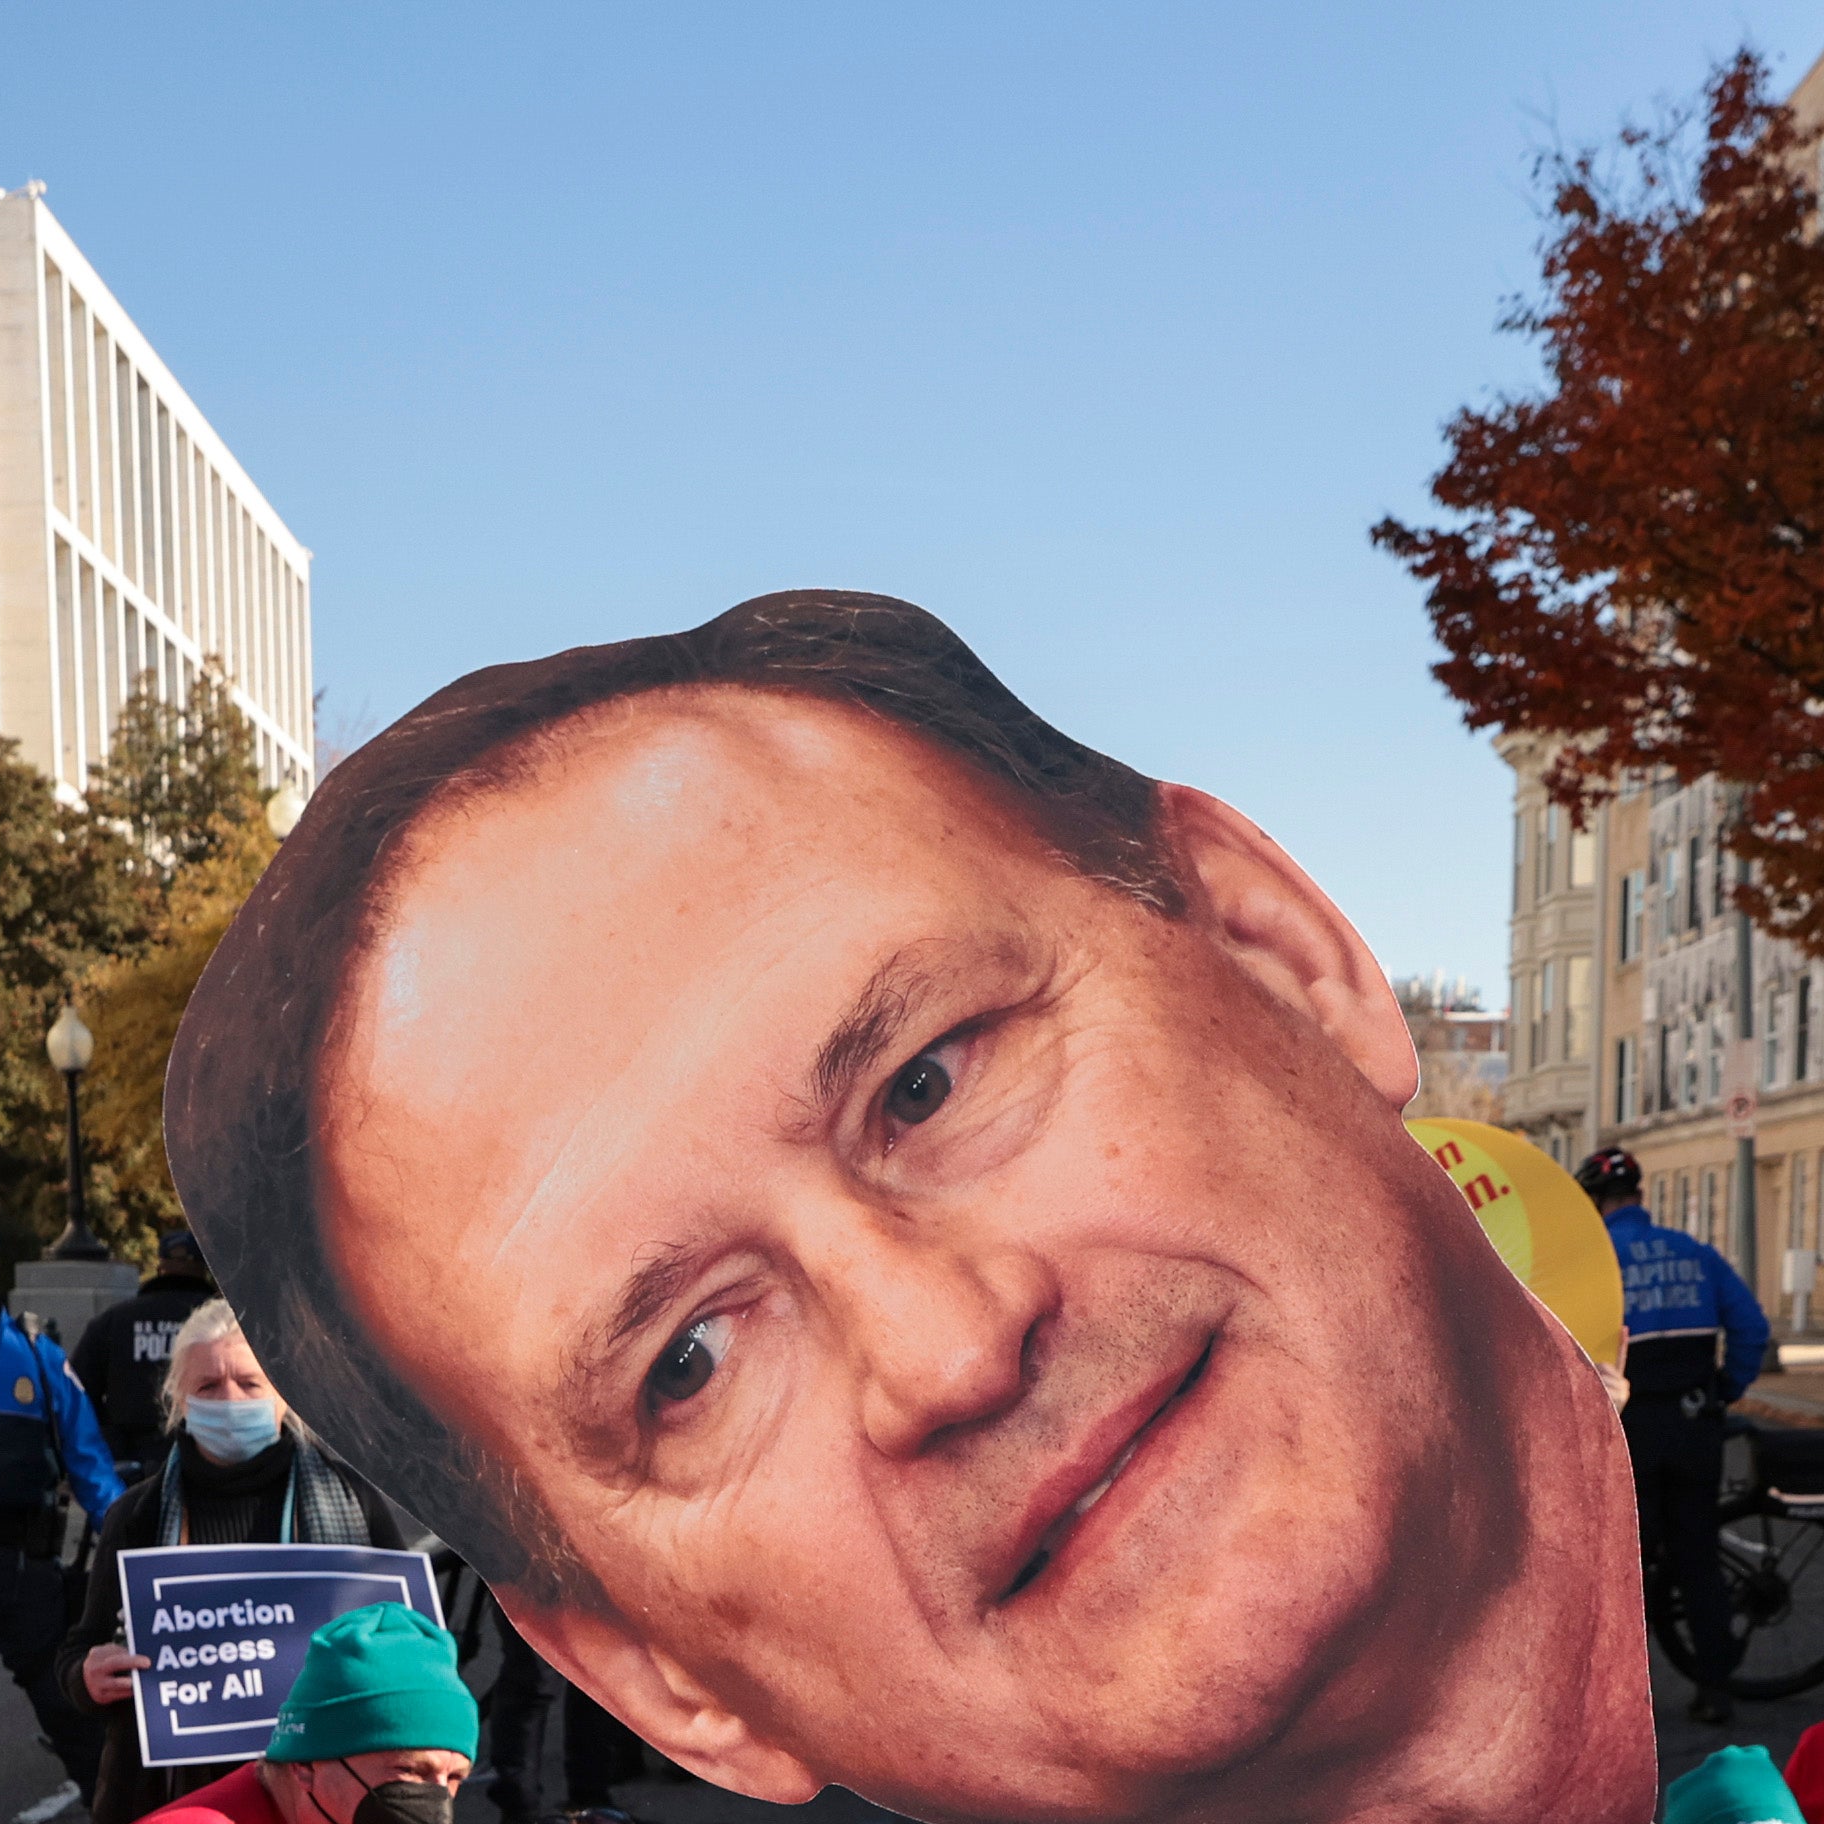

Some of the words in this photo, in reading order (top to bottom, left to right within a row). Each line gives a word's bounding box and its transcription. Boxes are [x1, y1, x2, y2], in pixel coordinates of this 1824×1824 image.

[1625, 1259, 1706, 1289] APITOL
[152, 1599, 295, 1635] Abortion
[156, 1638, 276, 1672] Access
[159, 1680, 212, 1707] For
[222, 1668, 263, 1700] All
